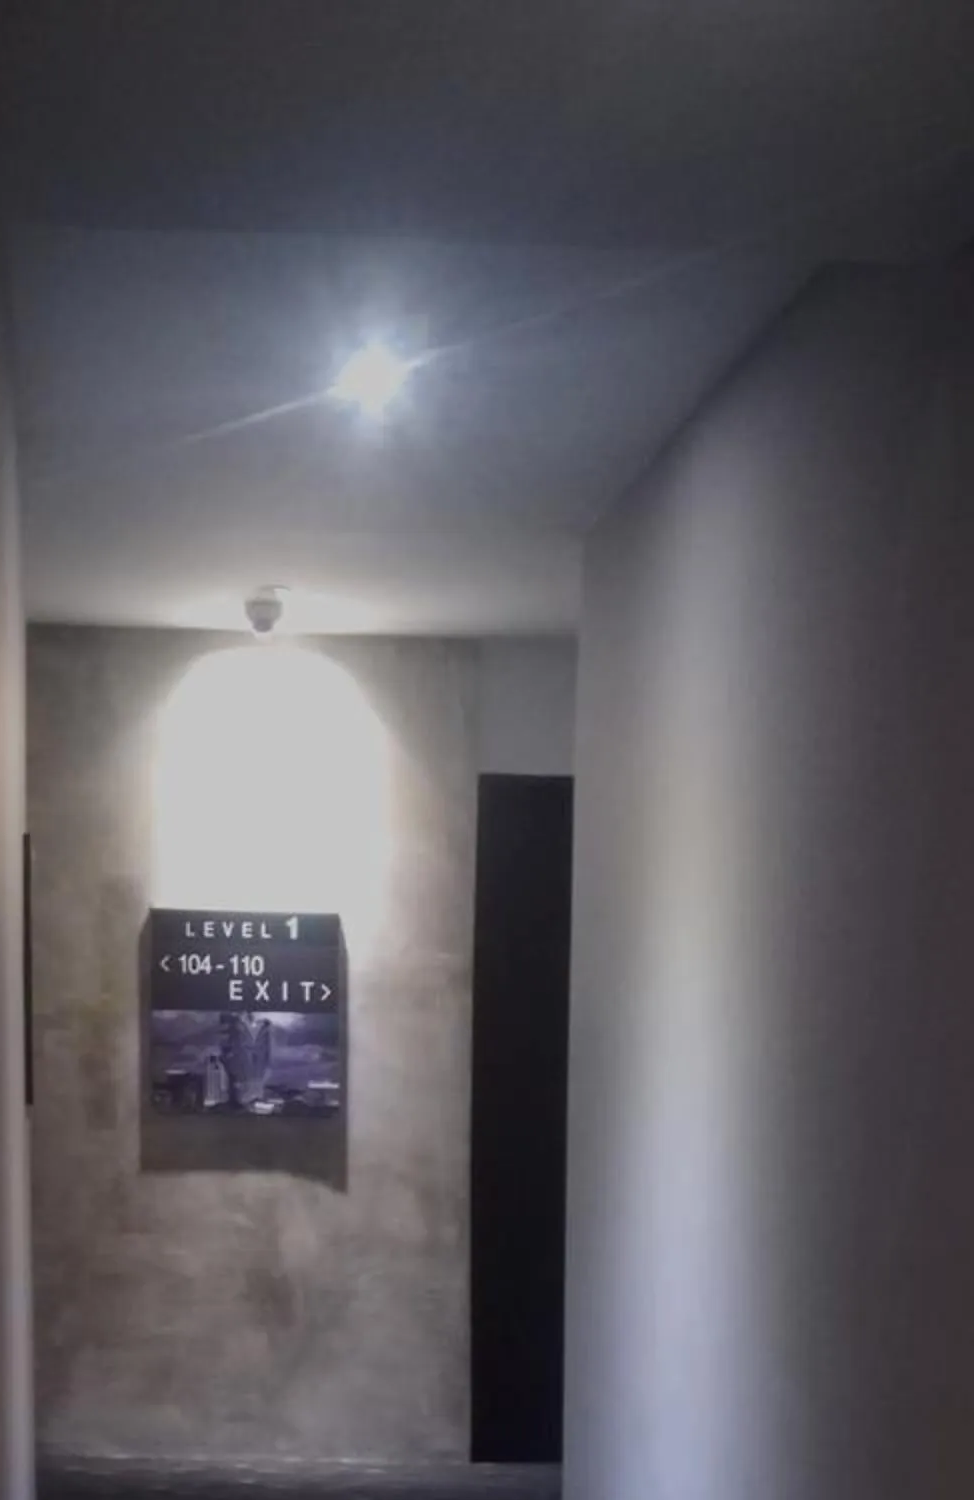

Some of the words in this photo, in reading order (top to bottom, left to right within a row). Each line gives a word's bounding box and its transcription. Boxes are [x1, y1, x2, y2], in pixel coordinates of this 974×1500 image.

[185, 921, 272, 938] LEVEL
[285, 916, 299, 940] 1
[229, 979, 315, 1001] EXIT
